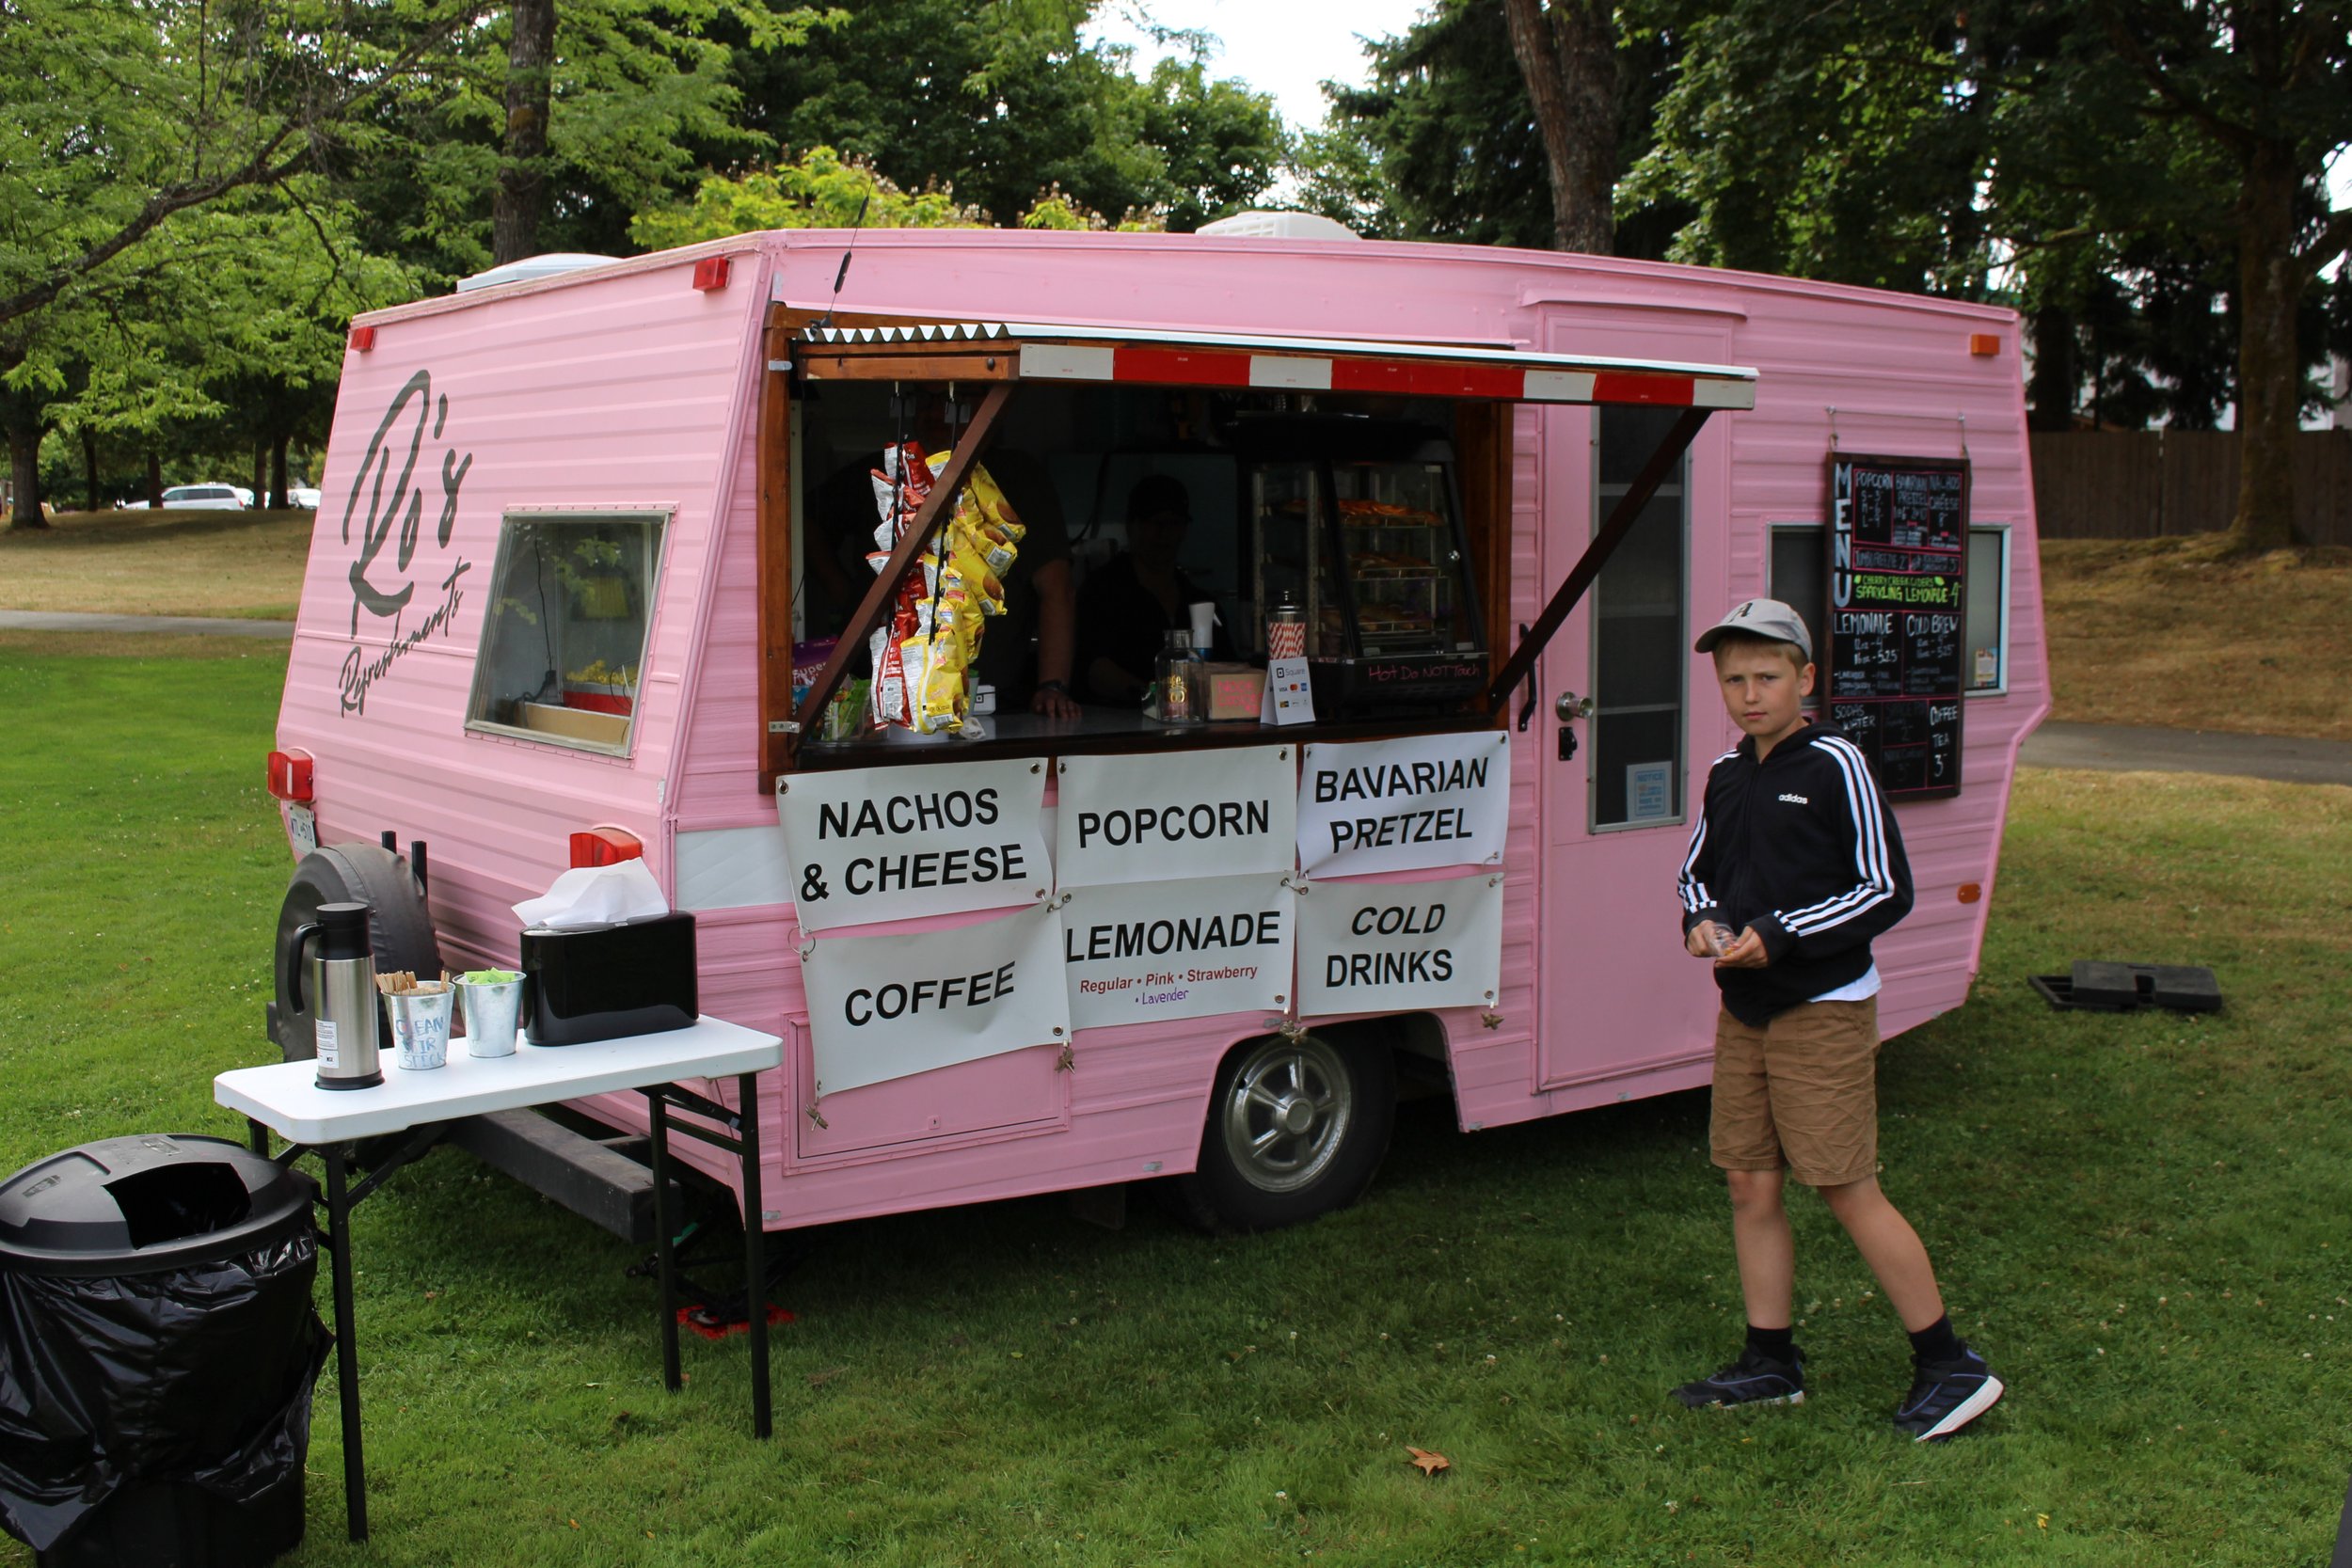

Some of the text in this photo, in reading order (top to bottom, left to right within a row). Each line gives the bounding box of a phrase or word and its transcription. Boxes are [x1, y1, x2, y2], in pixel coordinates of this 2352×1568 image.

[1855, 472, 1892, 489] POPCORN
[1835, 463, 1852, 608] MENU
[1905, 587, 1948, 603] LEMONADE
[1835, 612, 1894, 634] LEMONADE
[1906, 614, 1959, 637] COLD BREW
[1285, 668, 1306, 677] Square
[1369, 665, 1397, 682] Hot
[1400, 665, 1419, 681] Do
[1422, 664, 1449, 678] NOT
[1930, 705, 1958, 726] COFFEE
[1932, 733, 1949, 749] TEA
[1315, 756, 1489, 803] BAVARIAN
[1778, 793, 1807, 804] adidas
[818, 788, 999, 840] NACHOS
[1078, 800, 1269, 848] POPCORN
[1330, 807, 1472, 854] PRETZEL
[801, 844, 1027, 903] & CHEESE
[1351, 903, 1446, 937] COLD
[1066, 911, 1280, 963] LEMONADE
[1080, 964, 1258, 994] Regular Pink Strawberry
[1326, 948, 1453, 988] DRINKS
[845, 960, 1016, 1026] COFFEE
[1141, 987, 1189, 1006] Lavender
[396, 1017, 443, 1036] CEAN
[405, 1052, 447, 1067] STICK
